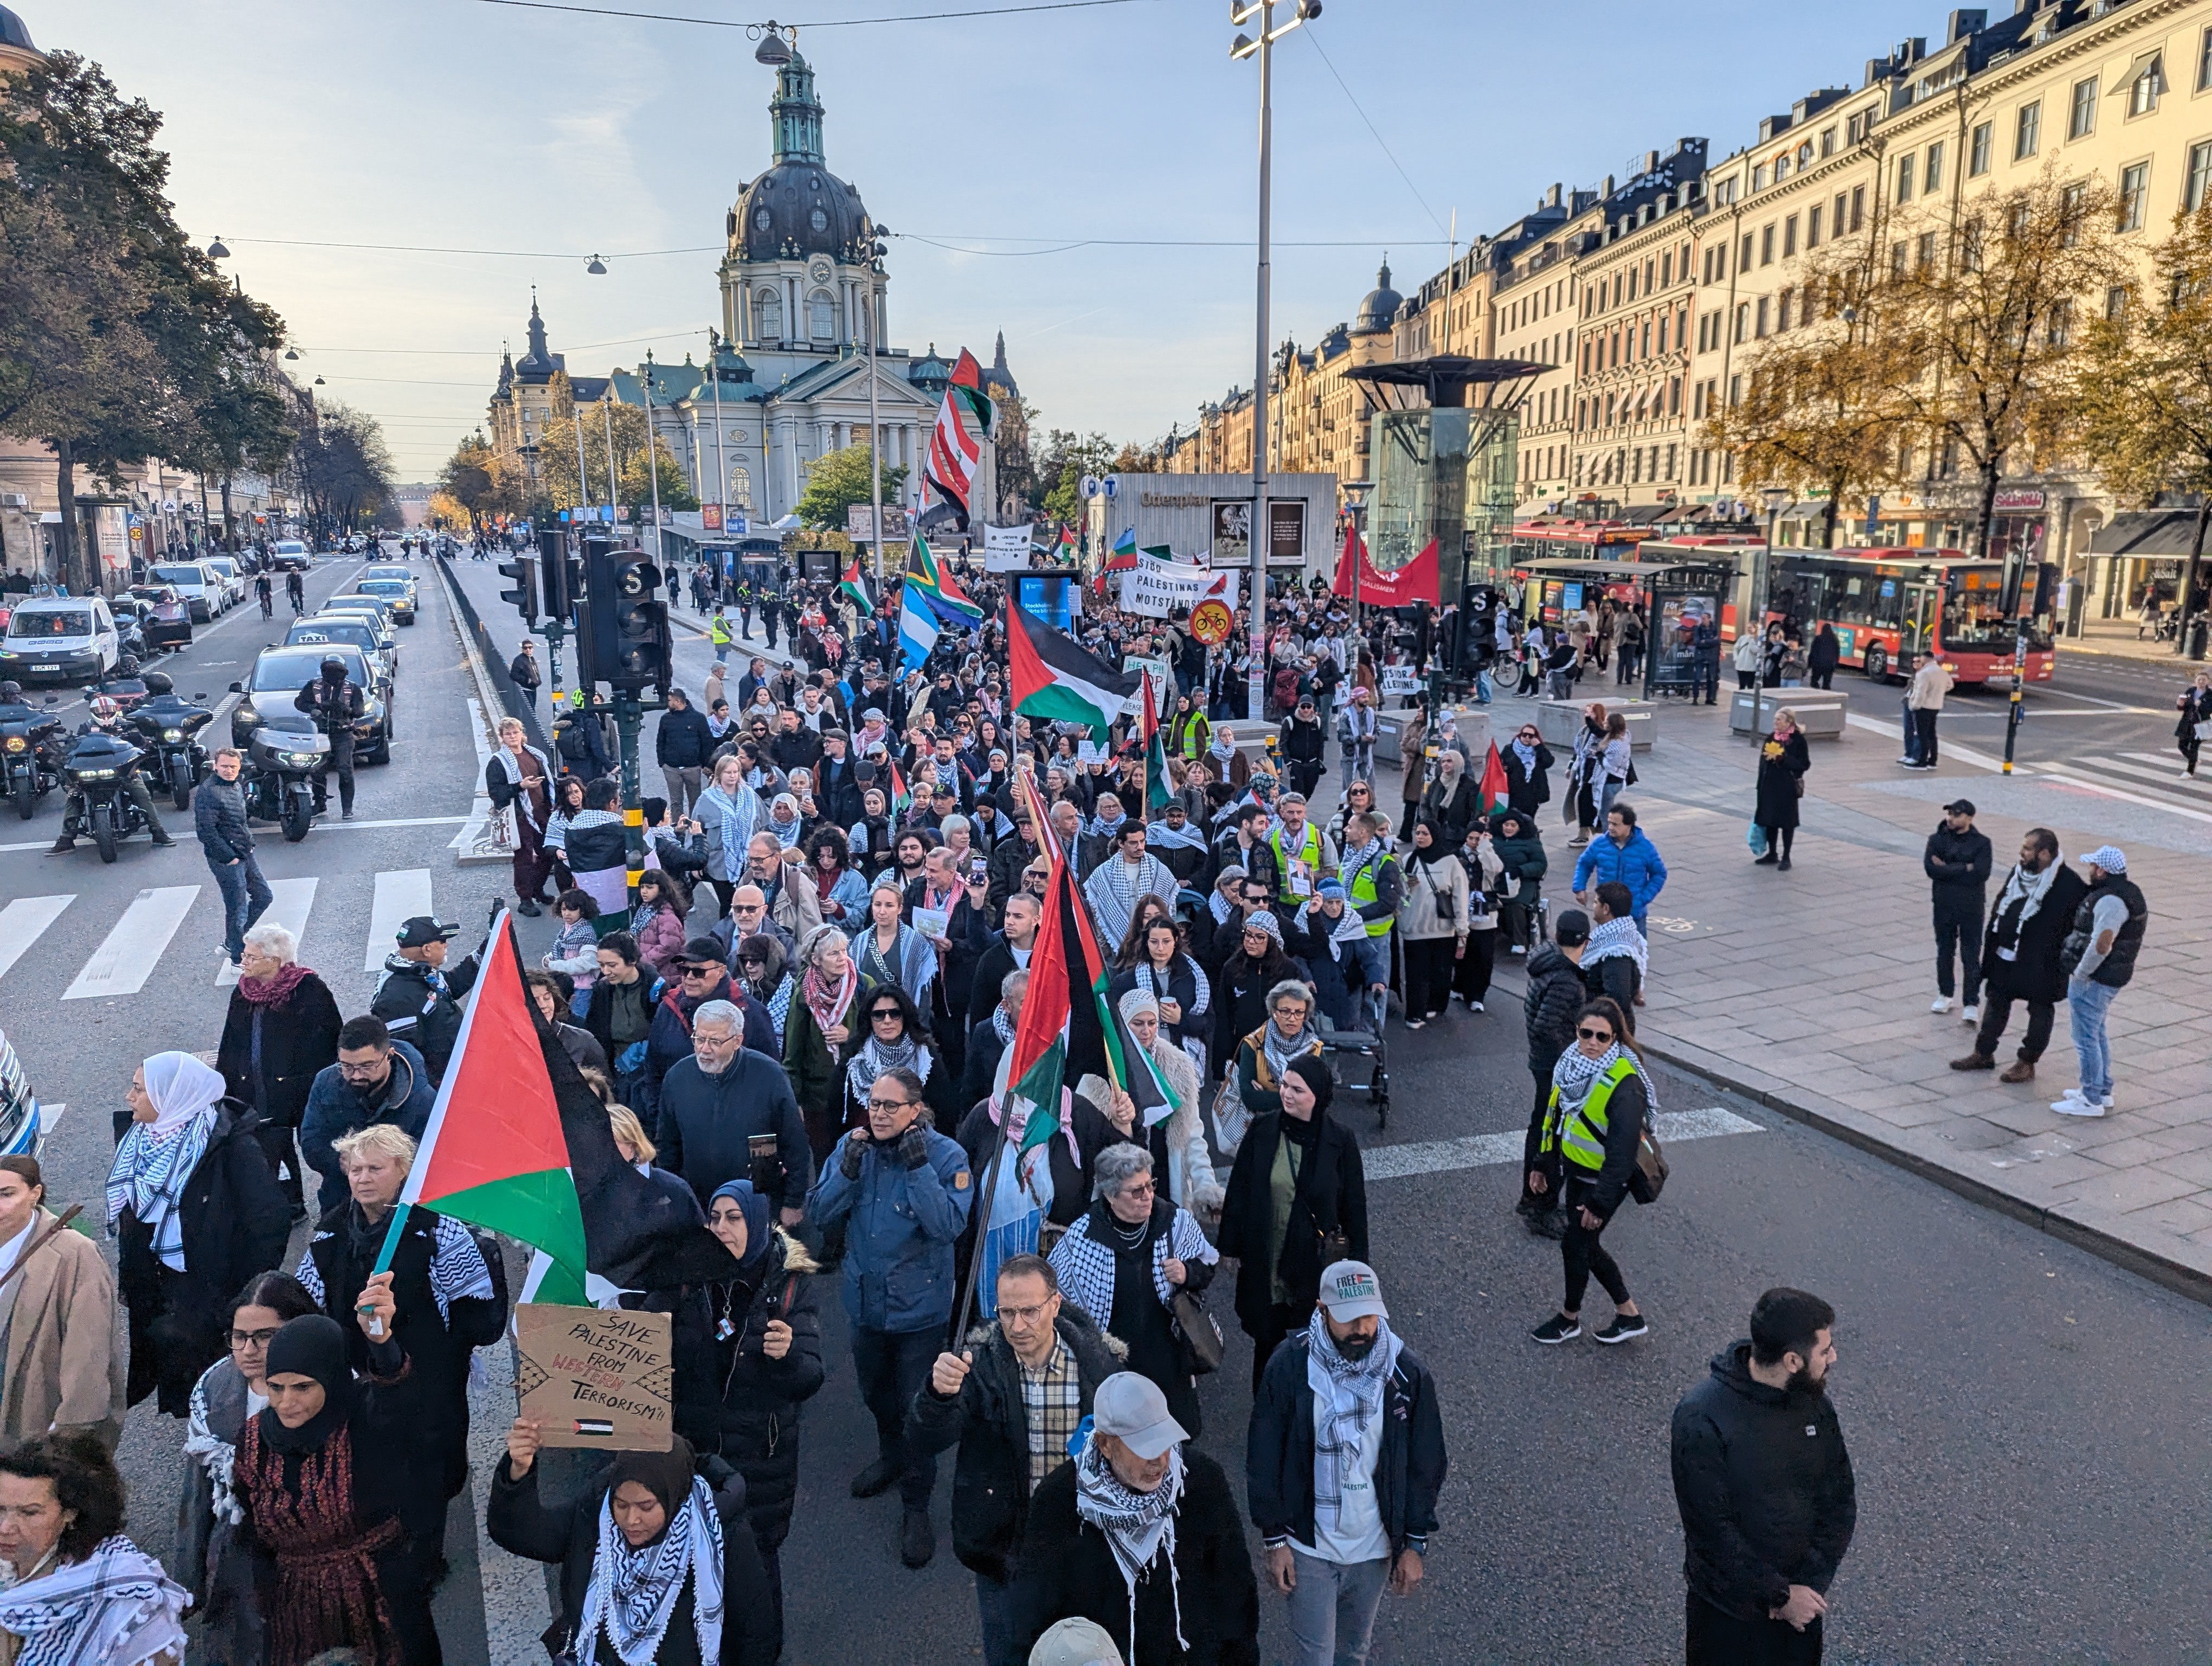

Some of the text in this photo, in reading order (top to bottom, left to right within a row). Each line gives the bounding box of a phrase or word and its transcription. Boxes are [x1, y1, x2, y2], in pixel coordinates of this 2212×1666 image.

[1104, 480, 1115, 495] T
[134, 493, 148, 509] GULD
[1141, 490, 1210, 510] Odenplan
[1136, 575, 1199, 592] PALESTINAS
[1664, 601, 1679, 610] För
[1382, 680, 1414, 690] ALESTINE
[1123, 701, 1143, 712] PLEASE
[1336, 1274, 1358, 1289] FREE
[1338, 1284, 1375, 1299] PALESTINE
[568, 1323, 661, 1366] PALESTINE
[587, 1352, 627, 1373] FROM
[552, 1353, 625, 1391] WESTERN
